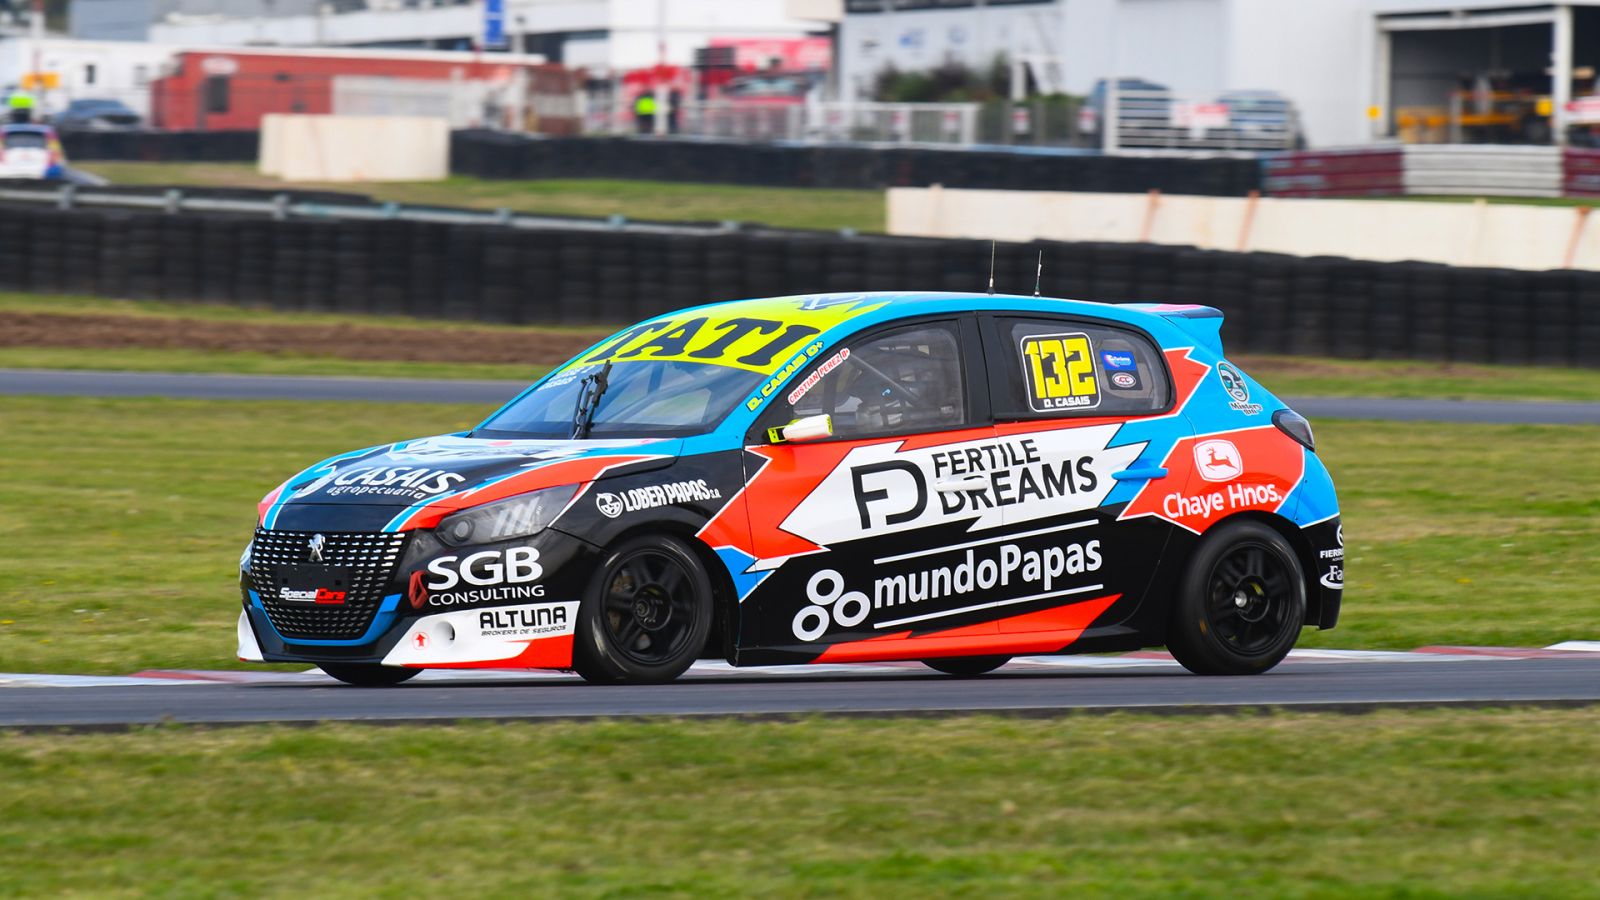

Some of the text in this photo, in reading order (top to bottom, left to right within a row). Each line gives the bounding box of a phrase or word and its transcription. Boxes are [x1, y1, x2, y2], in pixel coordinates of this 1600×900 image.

[747, 397, 763, 411] D.
[761, 354, 807, 397] CASAIS
[789, 373, 819, 403] CRISTIAN
[819, 354, 842, 375] PEREZ
[1025, 338, 1096, 399] 132
[1043, 396, 1090, 408] D. CASAIS
[932, 438, 1041, 479] FERTILE
[326, 484, 427, 499] agropecuaria
[334, 467, 466, 493] CASAIS
[620, 485, 667, 512] LOBER
[662, 479, 710, 504] PAPAS
[936, 456, 1098, 516] DREAMS
[1163, 483, 1283, 519] Chaye Hnos.
[427, 546, 543, 591] SGB
[874, 540, 1102, 609] mundoPapas
[429, 585, 545, 606] CONSULTING
[480, 606, 567, 629] ALTUNA
[532, 624, 567, 633] SEGUROS
